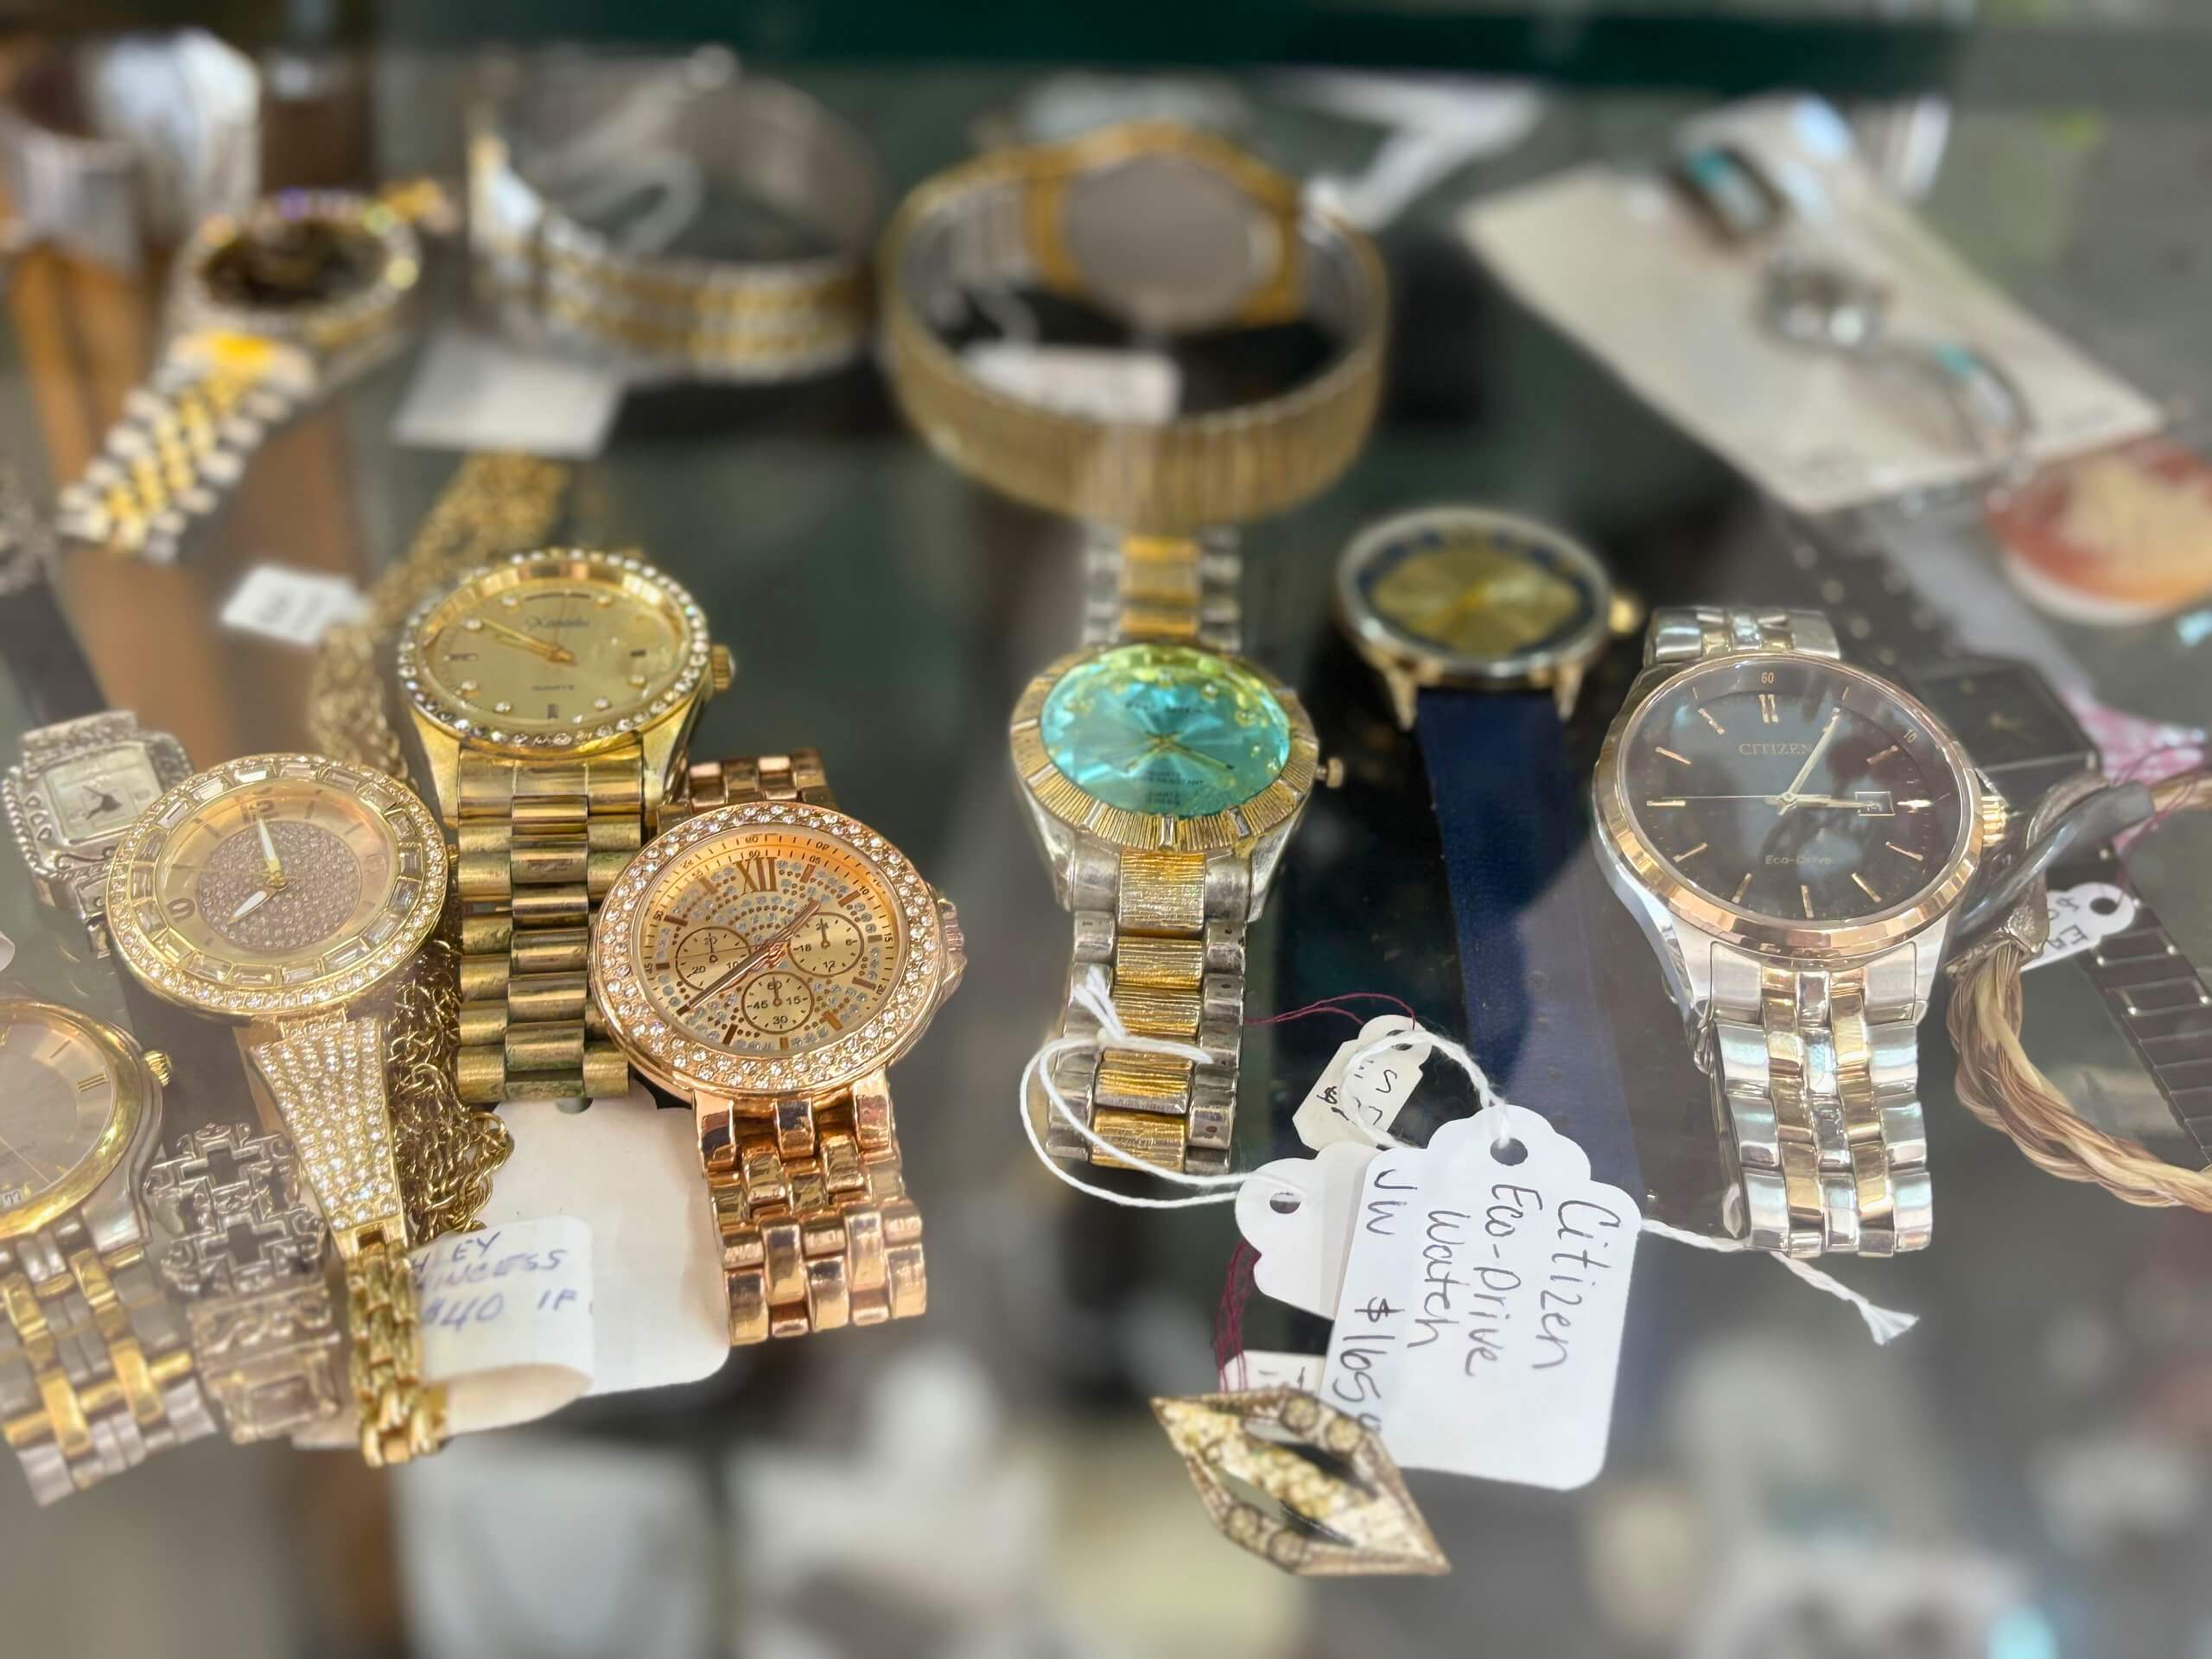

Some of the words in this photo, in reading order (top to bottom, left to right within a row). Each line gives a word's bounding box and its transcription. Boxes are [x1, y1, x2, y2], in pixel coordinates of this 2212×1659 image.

[1761, 671, 1775, 684] 60
[1904, 729, 1917, 743] 10
[733, 856, 779, 896] XII
[859, 885, 870, 895] 10
[884, 932, 893, 943] 15
[772, 1015, 789, 1025] 30
[1407, 1210, 1471, 1349] Watch
[1532, 1199, 1622, 1370] Citizen
